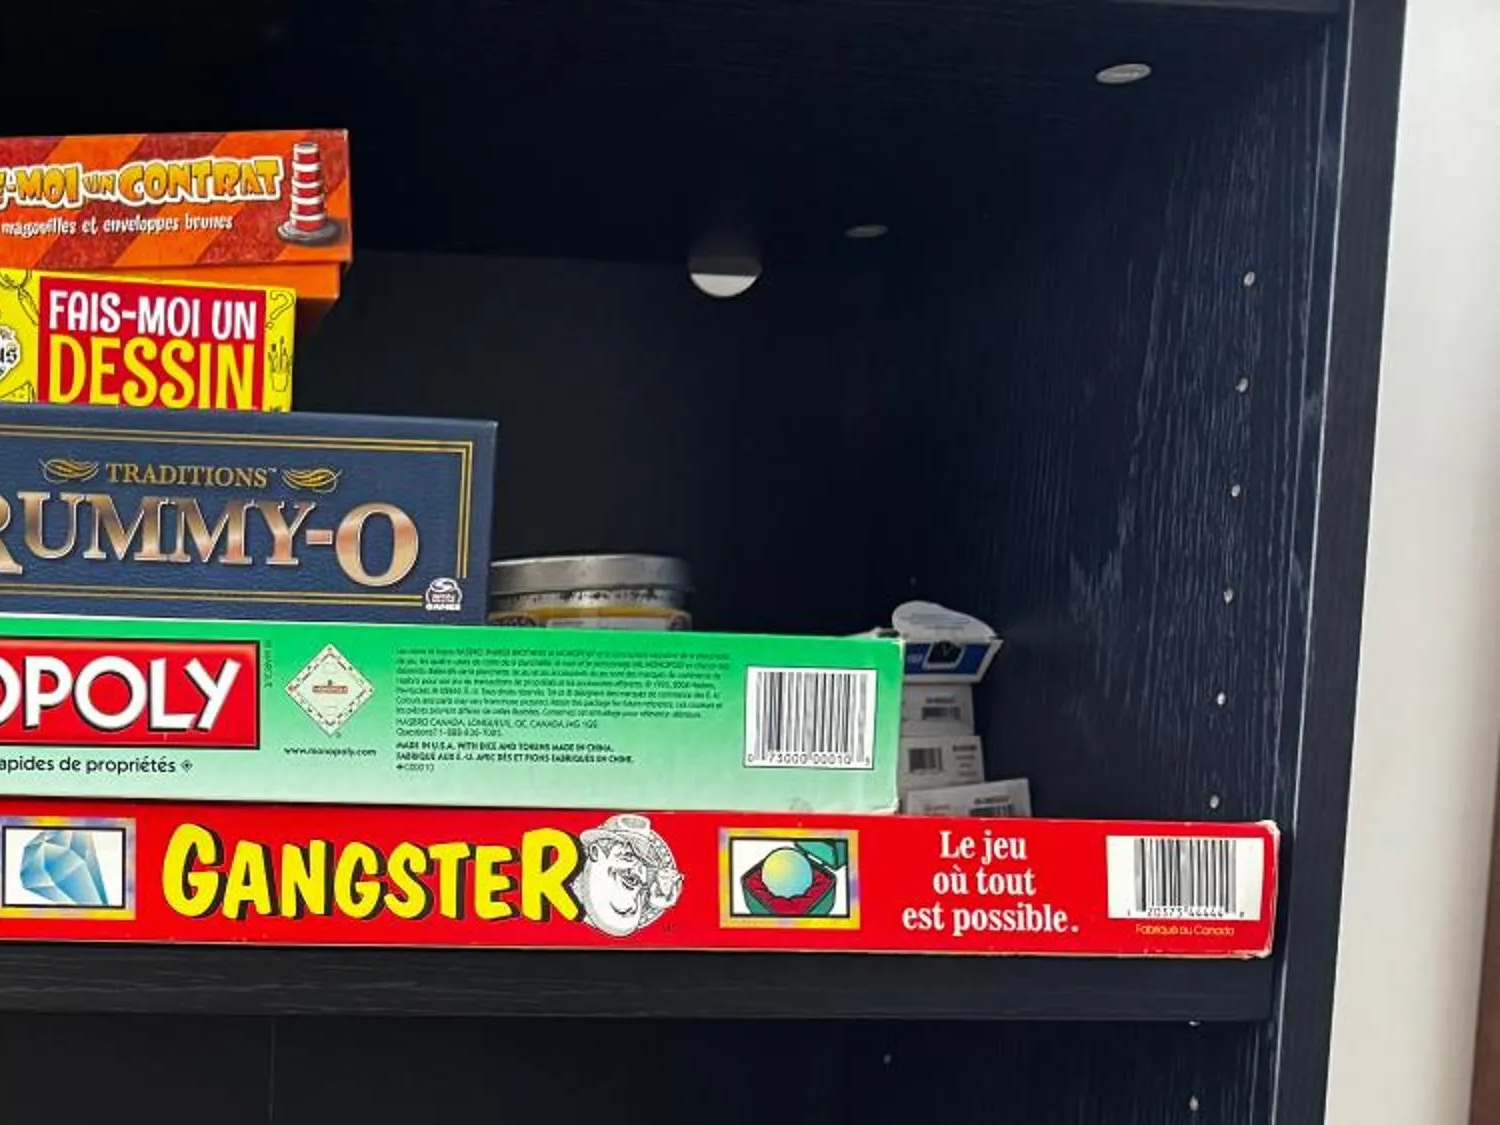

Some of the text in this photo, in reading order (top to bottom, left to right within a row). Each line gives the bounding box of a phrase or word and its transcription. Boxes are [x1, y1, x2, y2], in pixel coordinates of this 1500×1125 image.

[116, 157, 283, 204] CONTRAT
[82, 218, 98, 235] et
[102, 216, 179, 236] enveloppes
[184, 213, 233, 231] brunes
[48, 290, 257, 340] FAIS-MOI UN
[49, 334, 255, 412] DESSIN
[59, 755, 82, 772] de
[85, 754, 177, 777] propriétés
[939, 829, 1029, 865] Le jeu
[161, 822, 582, 923] GANGSTER
[932, 865, 1037, 897] où tout
[901, 903, 1080, 937] est possible.
